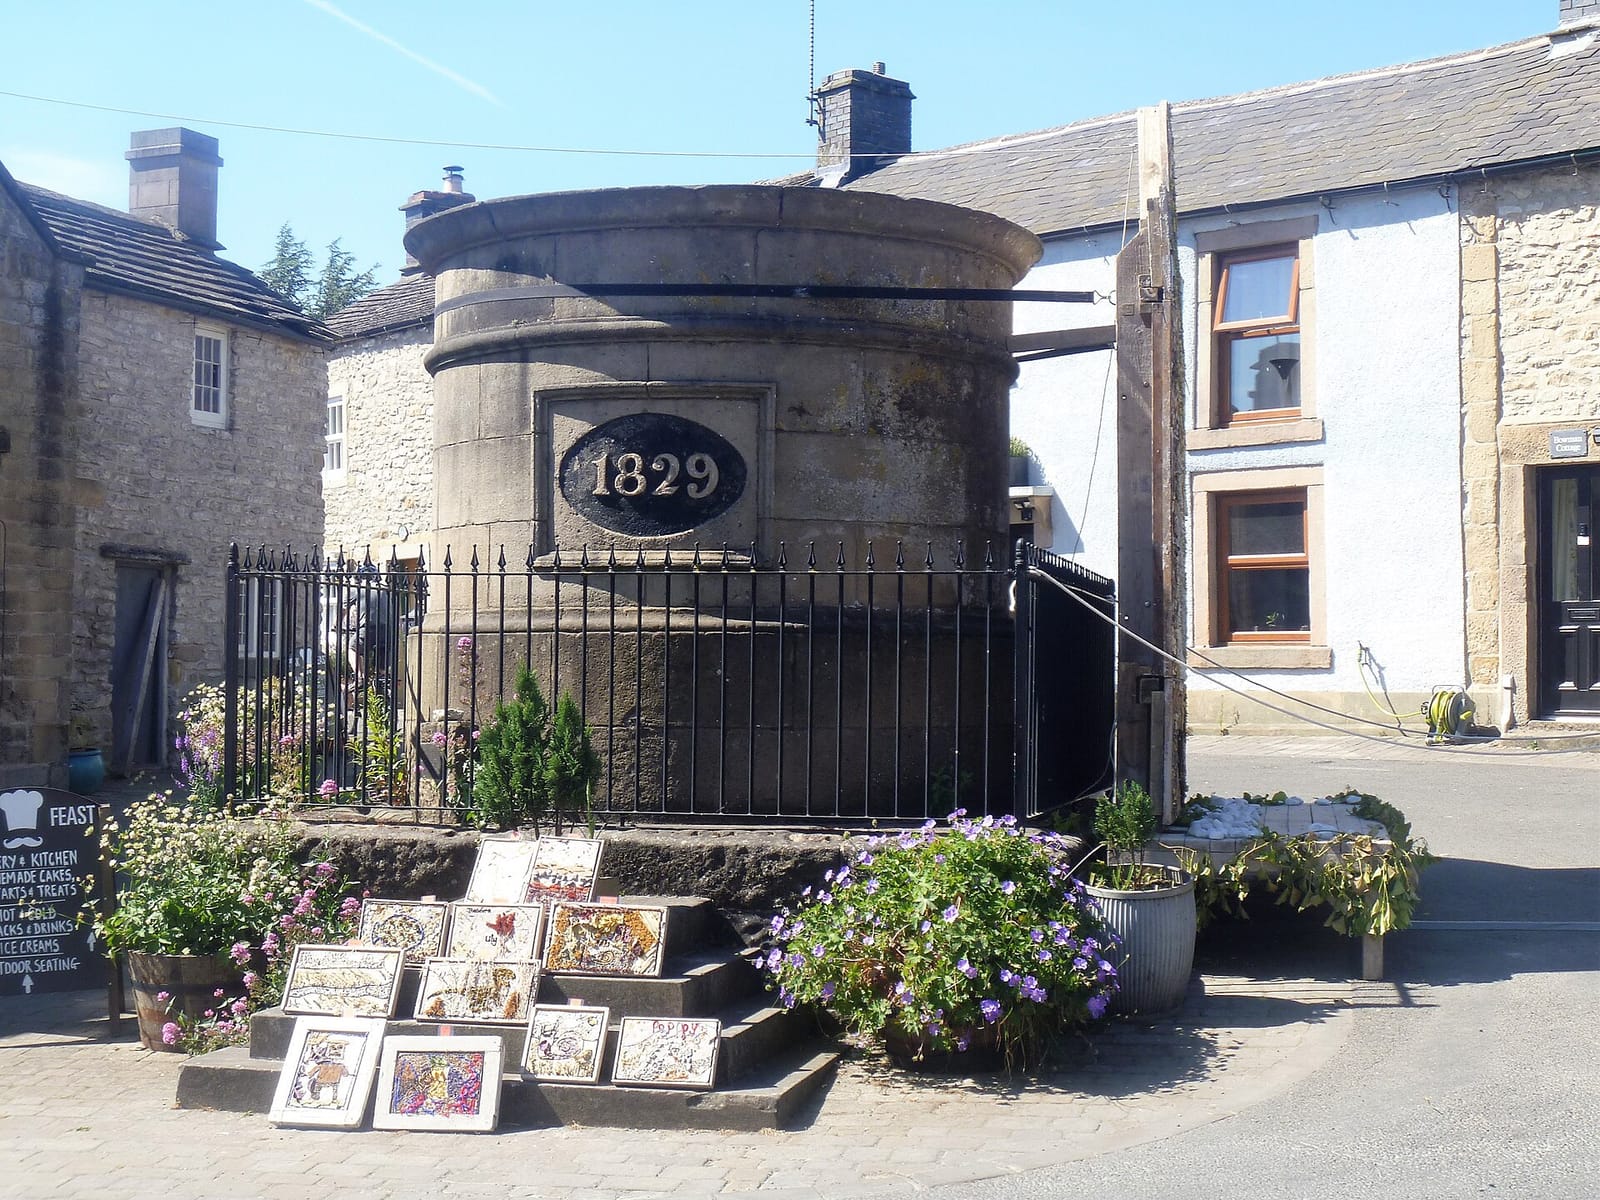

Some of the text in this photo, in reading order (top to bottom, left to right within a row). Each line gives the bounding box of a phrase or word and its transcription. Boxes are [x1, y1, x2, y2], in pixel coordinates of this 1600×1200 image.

[1555, 443, 1582, 452] Cottage
[591, 452, 720, 499] 1829
[50, 804, 96, 827] FEAST
[0, 854, 17, 869] RY
[31, 849, 78, 867] KITCHEN
[0, 868, 75, 884] EMADE CAKES,
[0, 886, 27, 900] ARTS
[36, 884, 77, 897] TREATS
[33, 920, 73, 935] DRINKS
[0, 938, 60, 954] ICE CREAMS
[34, 957, 81, 973] SEATING
